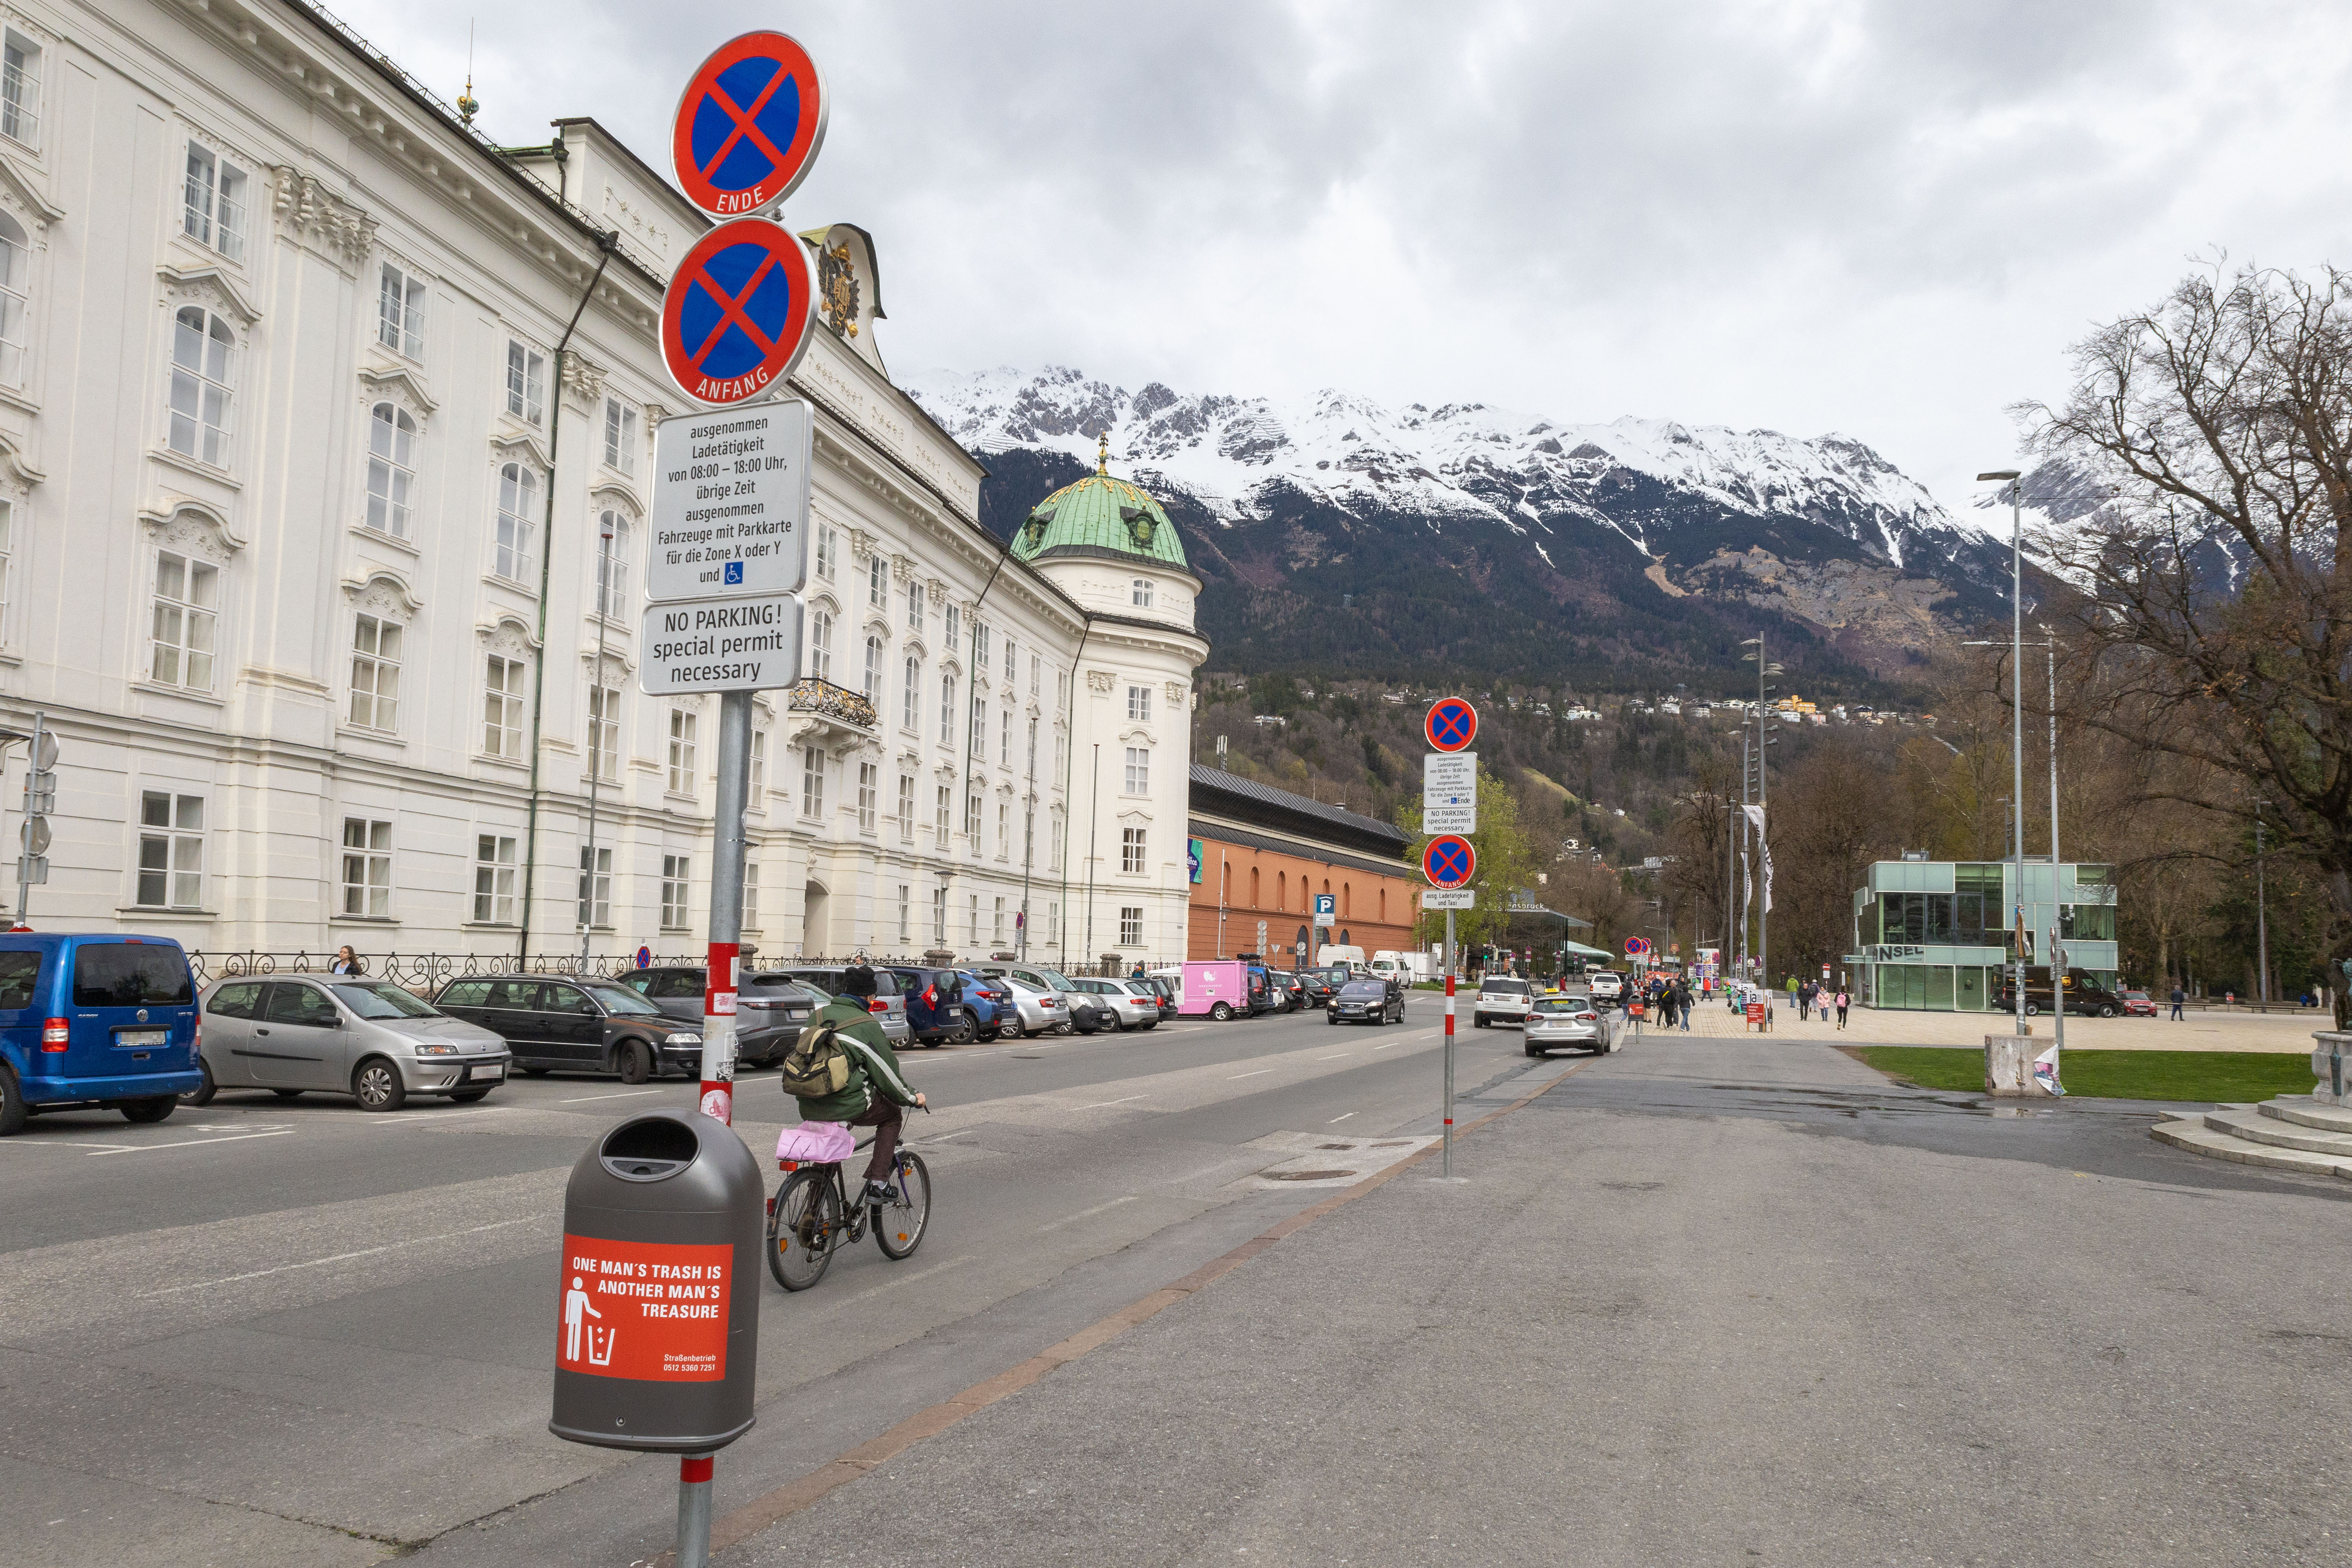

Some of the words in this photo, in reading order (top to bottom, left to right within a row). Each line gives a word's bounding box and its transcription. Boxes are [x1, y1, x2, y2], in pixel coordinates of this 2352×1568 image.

[717, 186, 765, 212] ENDE
[696, 367, 769, 399] ANFANG
[691, 417, 768, 439] ausgenommen
[692, 437, 764, 459] Ladetätigkeit
[668, 470, 687, 483] von
[691, 463, 719, 479] 08:00
[734, 458, 761, 475] 18:00
[765, 456, 787, 471] Uhr,
[697, 484, 731, 501] übrige
[734, 480, 755, 495] Zeit
[686, 503, 764, 523] ausgenommen
[659, 529, 712, 545] Fahrzeuge
[716, 524, 734, 539] mit
[738, 520, 792, 537] Parkkarte
[666, 550, 682, 565] für
[686, 549, 702, 563] die
[705, 547, 731, 561] Zone
[734, 544, 742, 559] X
[745, 543, 771, 557] oder
[774, 541, 781, 555] Y
[700, 568, 720, 583] und
[665, 612, 688, 632] NO
[653, 635, 714, 662] special
[721, 630, 783, 658] permit
[671, 662, 761, 682] necessary
[1321, 900, 1331, 912] P
[1749, 991, 1757, 1005] ja
[573, 1257, 597, 1272] ONE
[652, 1265, 701, 1279] TRASH
[707, 1266, 721, 1279] IS
[598, 1280, 663, 1298] ANOTHER
[642, 1303, 719, 1318] TREASURE
[664, 1354, 716, 1362] Straßenbetrieb
